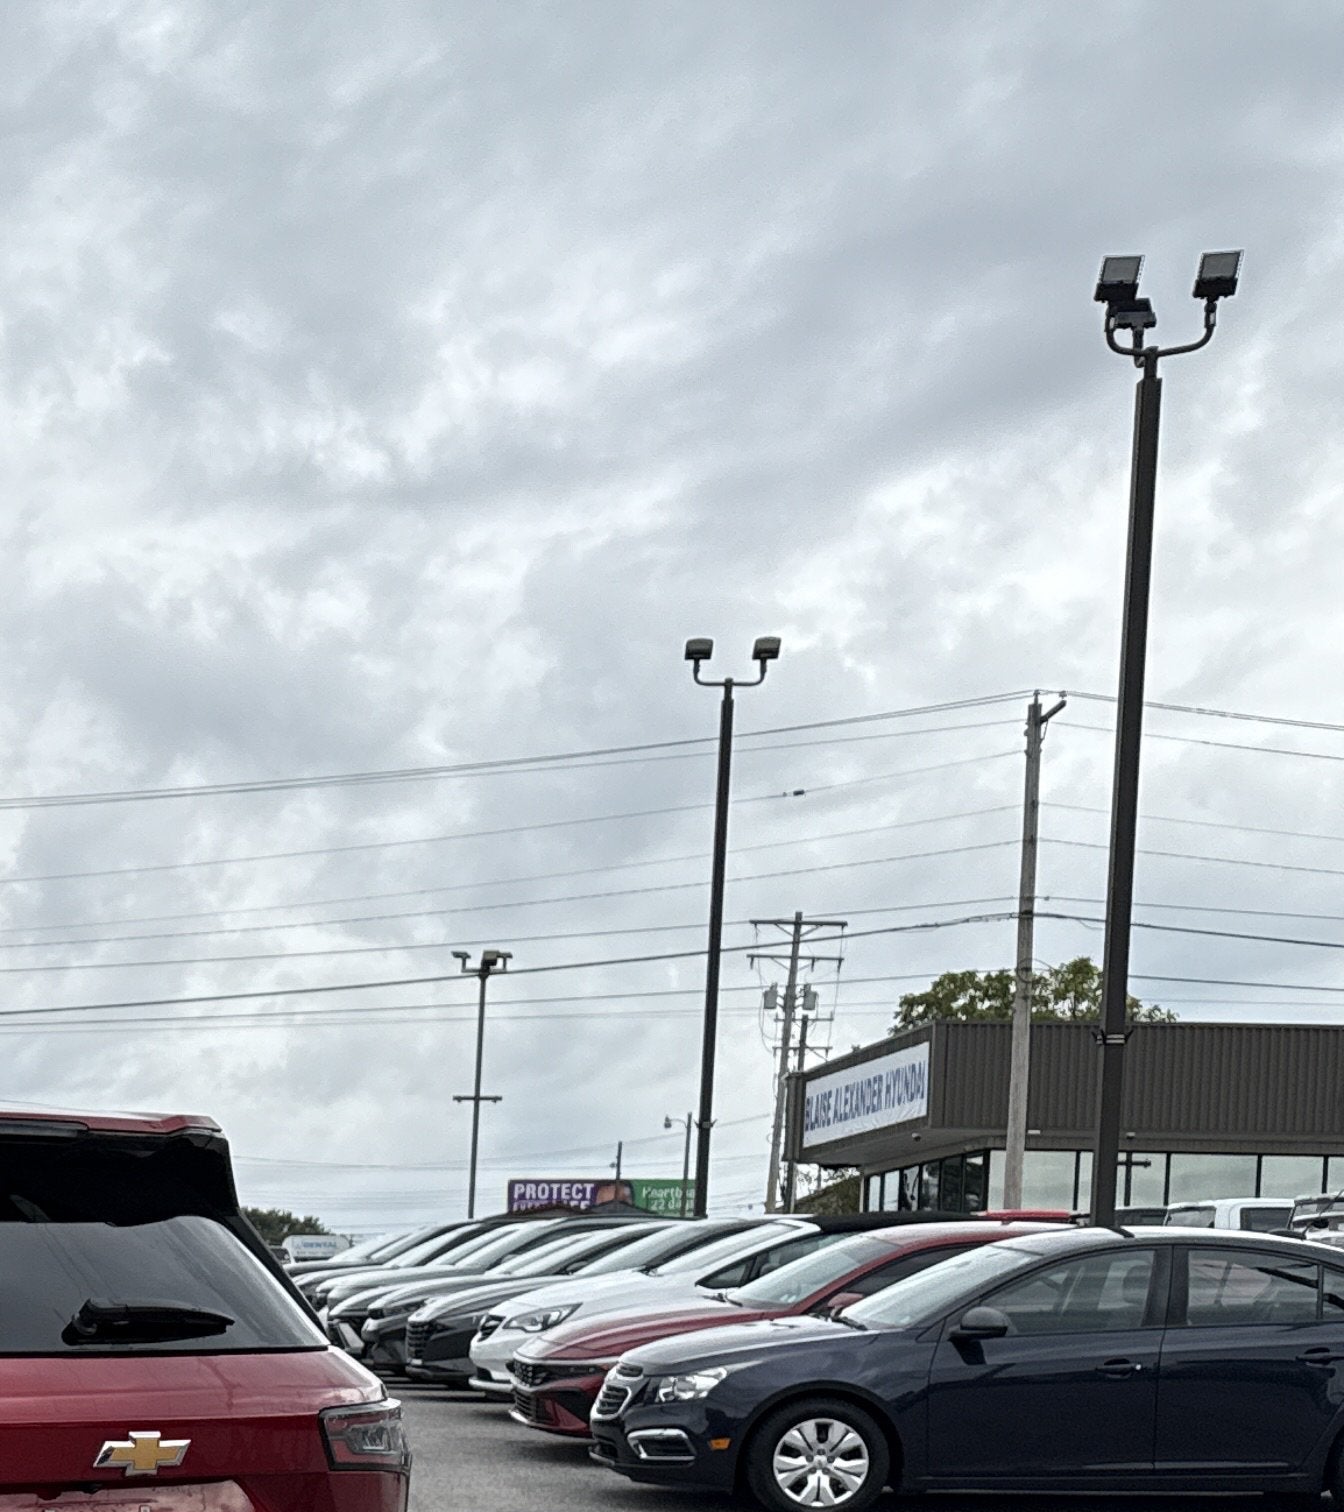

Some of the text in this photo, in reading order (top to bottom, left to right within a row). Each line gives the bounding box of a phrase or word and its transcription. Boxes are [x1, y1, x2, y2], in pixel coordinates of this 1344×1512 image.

[805, 1060, 926, 1132] BLAISE ALEXANDER HYUNDAI
[514, 1183, 594, 1200] PROTECT
